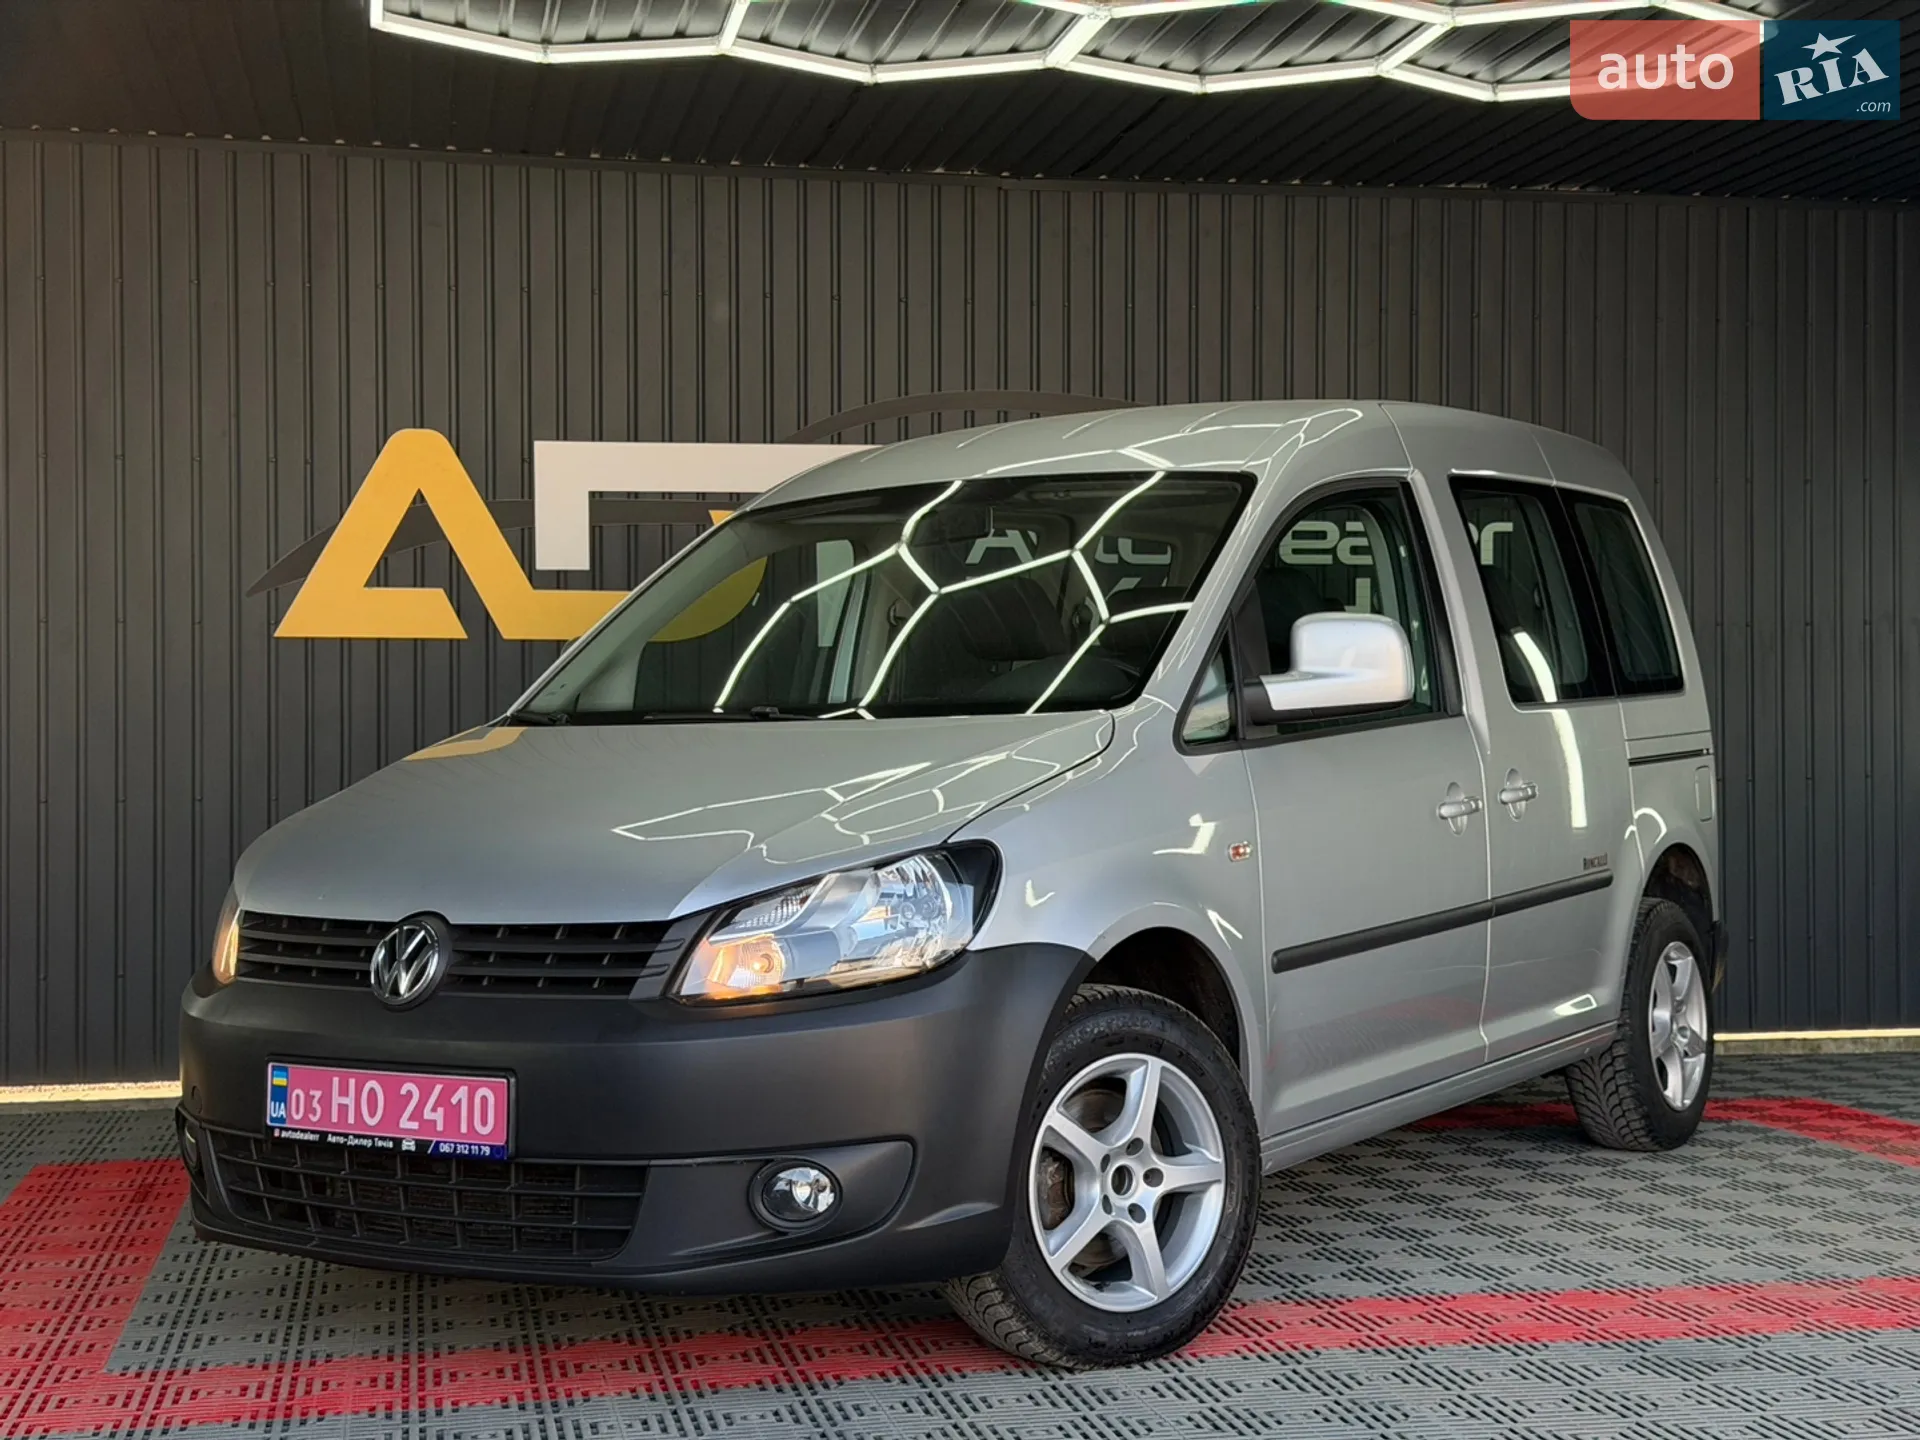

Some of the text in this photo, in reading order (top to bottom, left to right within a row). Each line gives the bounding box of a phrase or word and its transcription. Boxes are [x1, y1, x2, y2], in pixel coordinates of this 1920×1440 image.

[270, 1101, 287, 1118] UA
[291, 1076, 495, 1136] 03 HO 2410
[439, 1142, 455, 1154] 067
[456, 1143, 470, 1155] 312
[480, 1146, 491, 1157] 79
